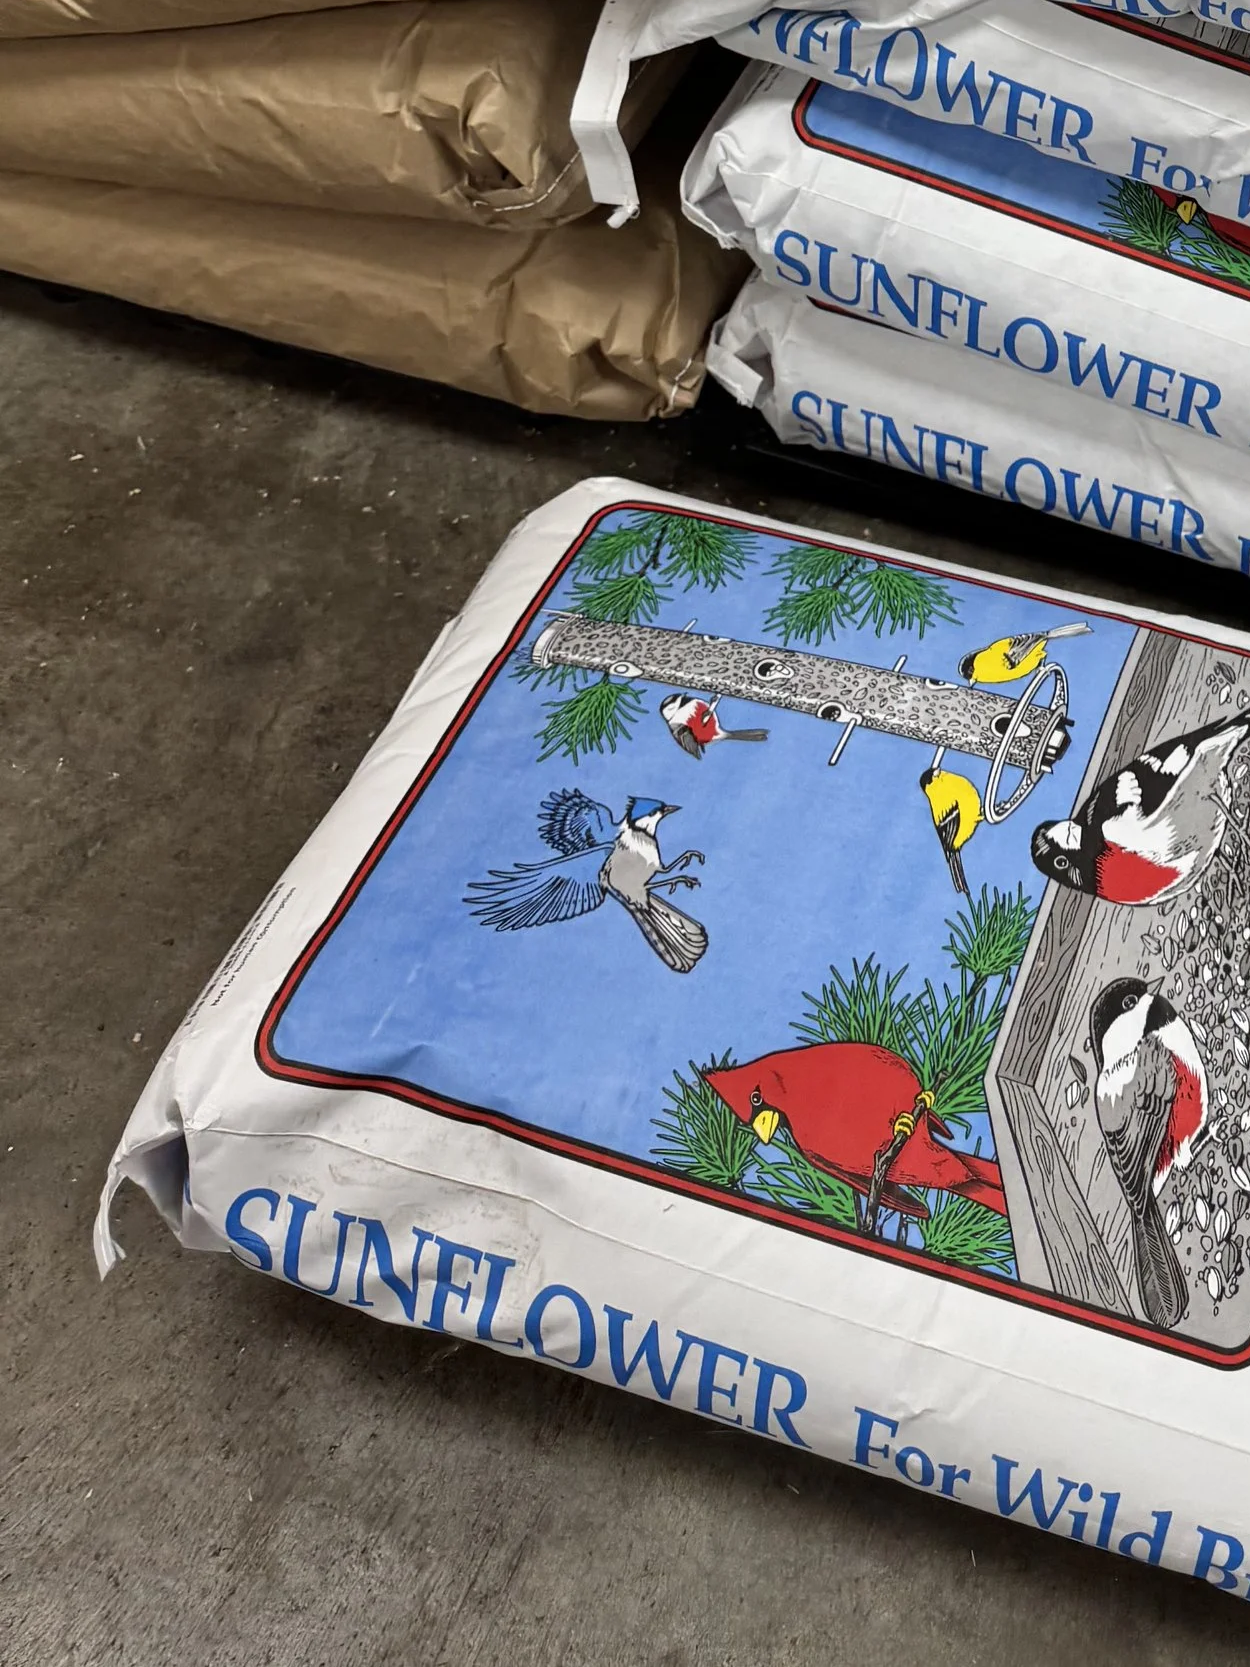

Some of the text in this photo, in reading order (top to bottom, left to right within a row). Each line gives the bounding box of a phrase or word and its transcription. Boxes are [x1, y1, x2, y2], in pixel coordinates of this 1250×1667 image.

[774, 230, 1222, 437] SUNFLOWER
[792, 390, 1213, 560] SUNFLOWER
[223, 1189, 811, 1449] SUNFLOWER
[849, 1407, 971, 1500] For
[992, 1454, 1173, 1566] Wild
